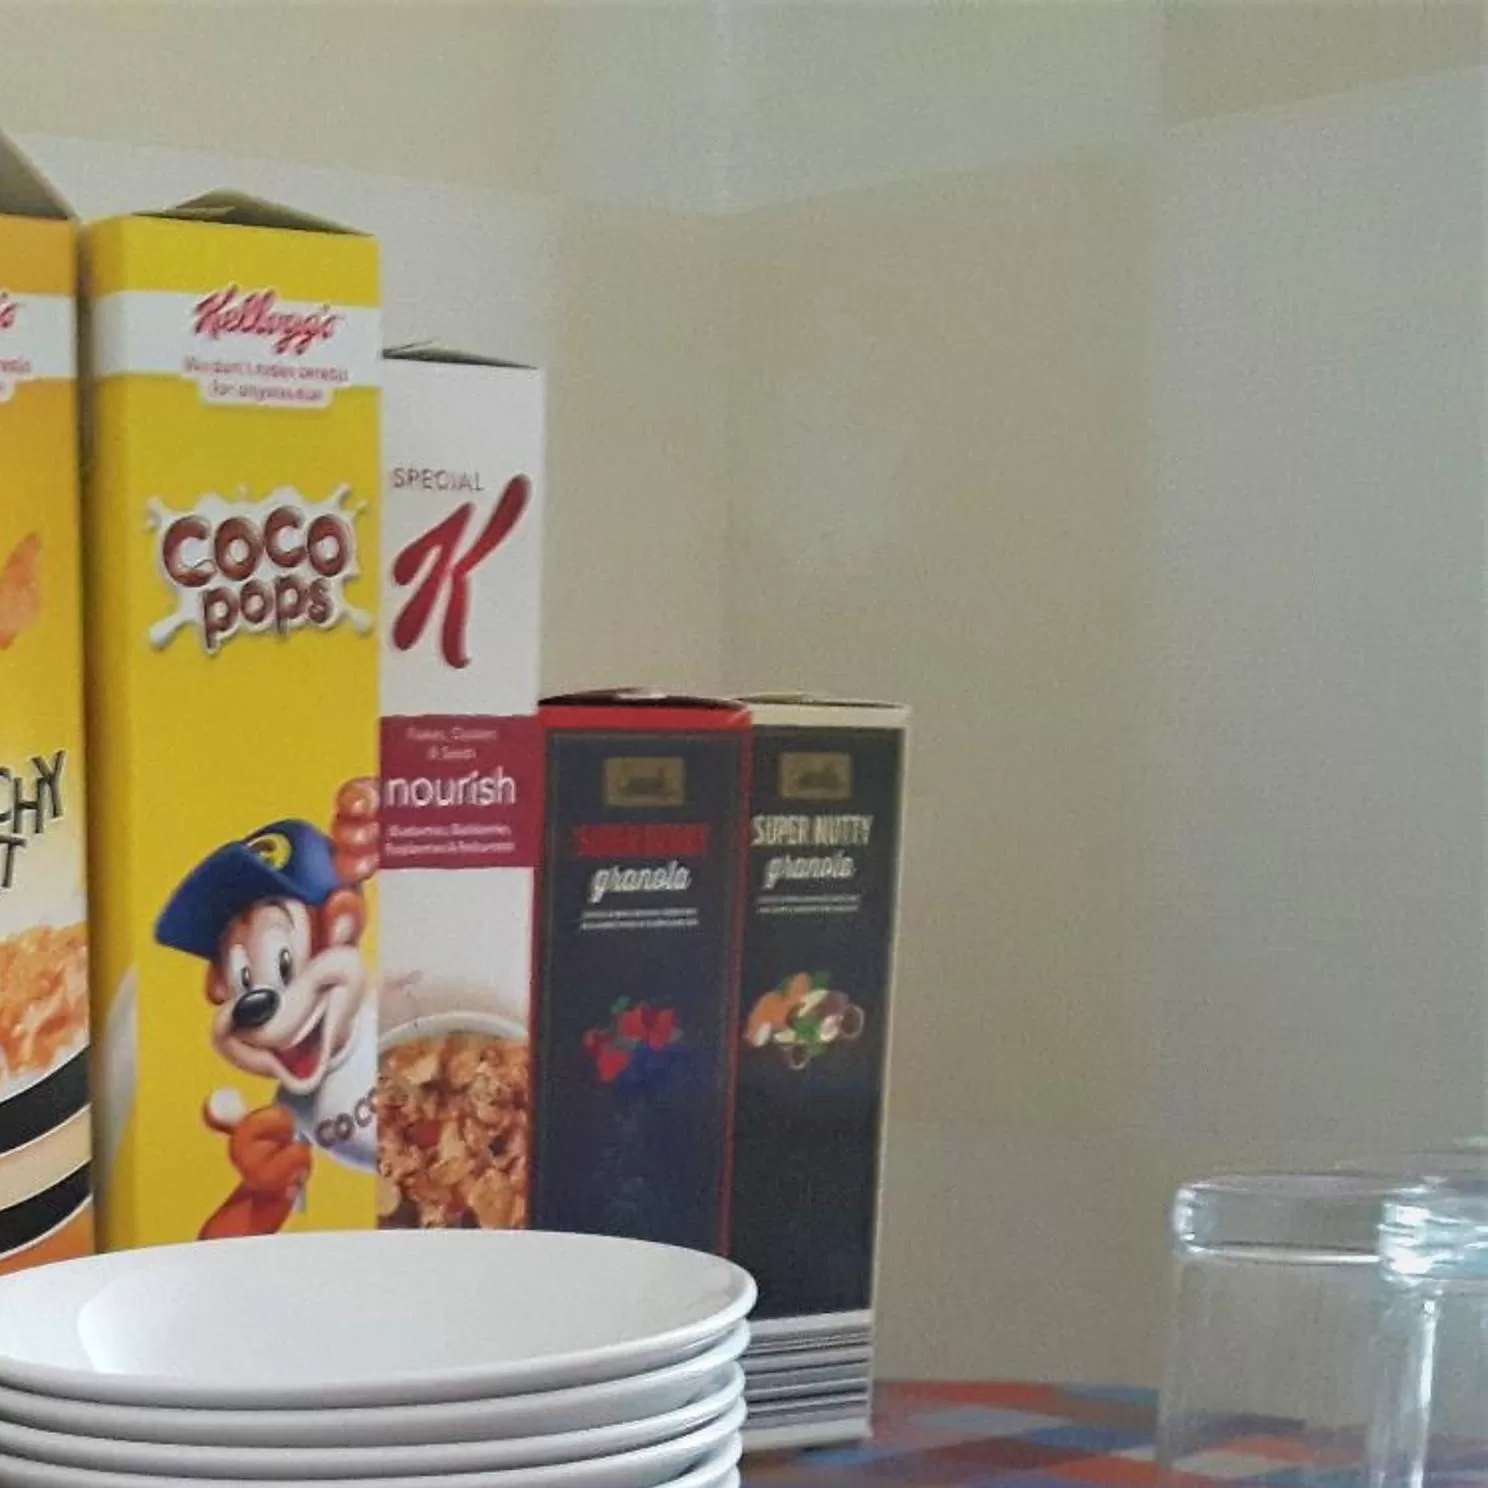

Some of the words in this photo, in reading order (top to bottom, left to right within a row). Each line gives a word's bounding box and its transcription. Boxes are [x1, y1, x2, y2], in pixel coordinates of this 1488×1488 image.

[191, 281, 346, 356] Kellogg's
[392, 467, 486, 492] SPECIAL
[391, 472, 533, 671] K
[202, 574, 335, 650] pops
[384, 765, 517, 808] nourish
[750, 813, 811, 847] SUPER
[813, 813, 875, 847] NUTTY
[587, 859, 693, 904] granola
[762, 848, 858, 890] granola
